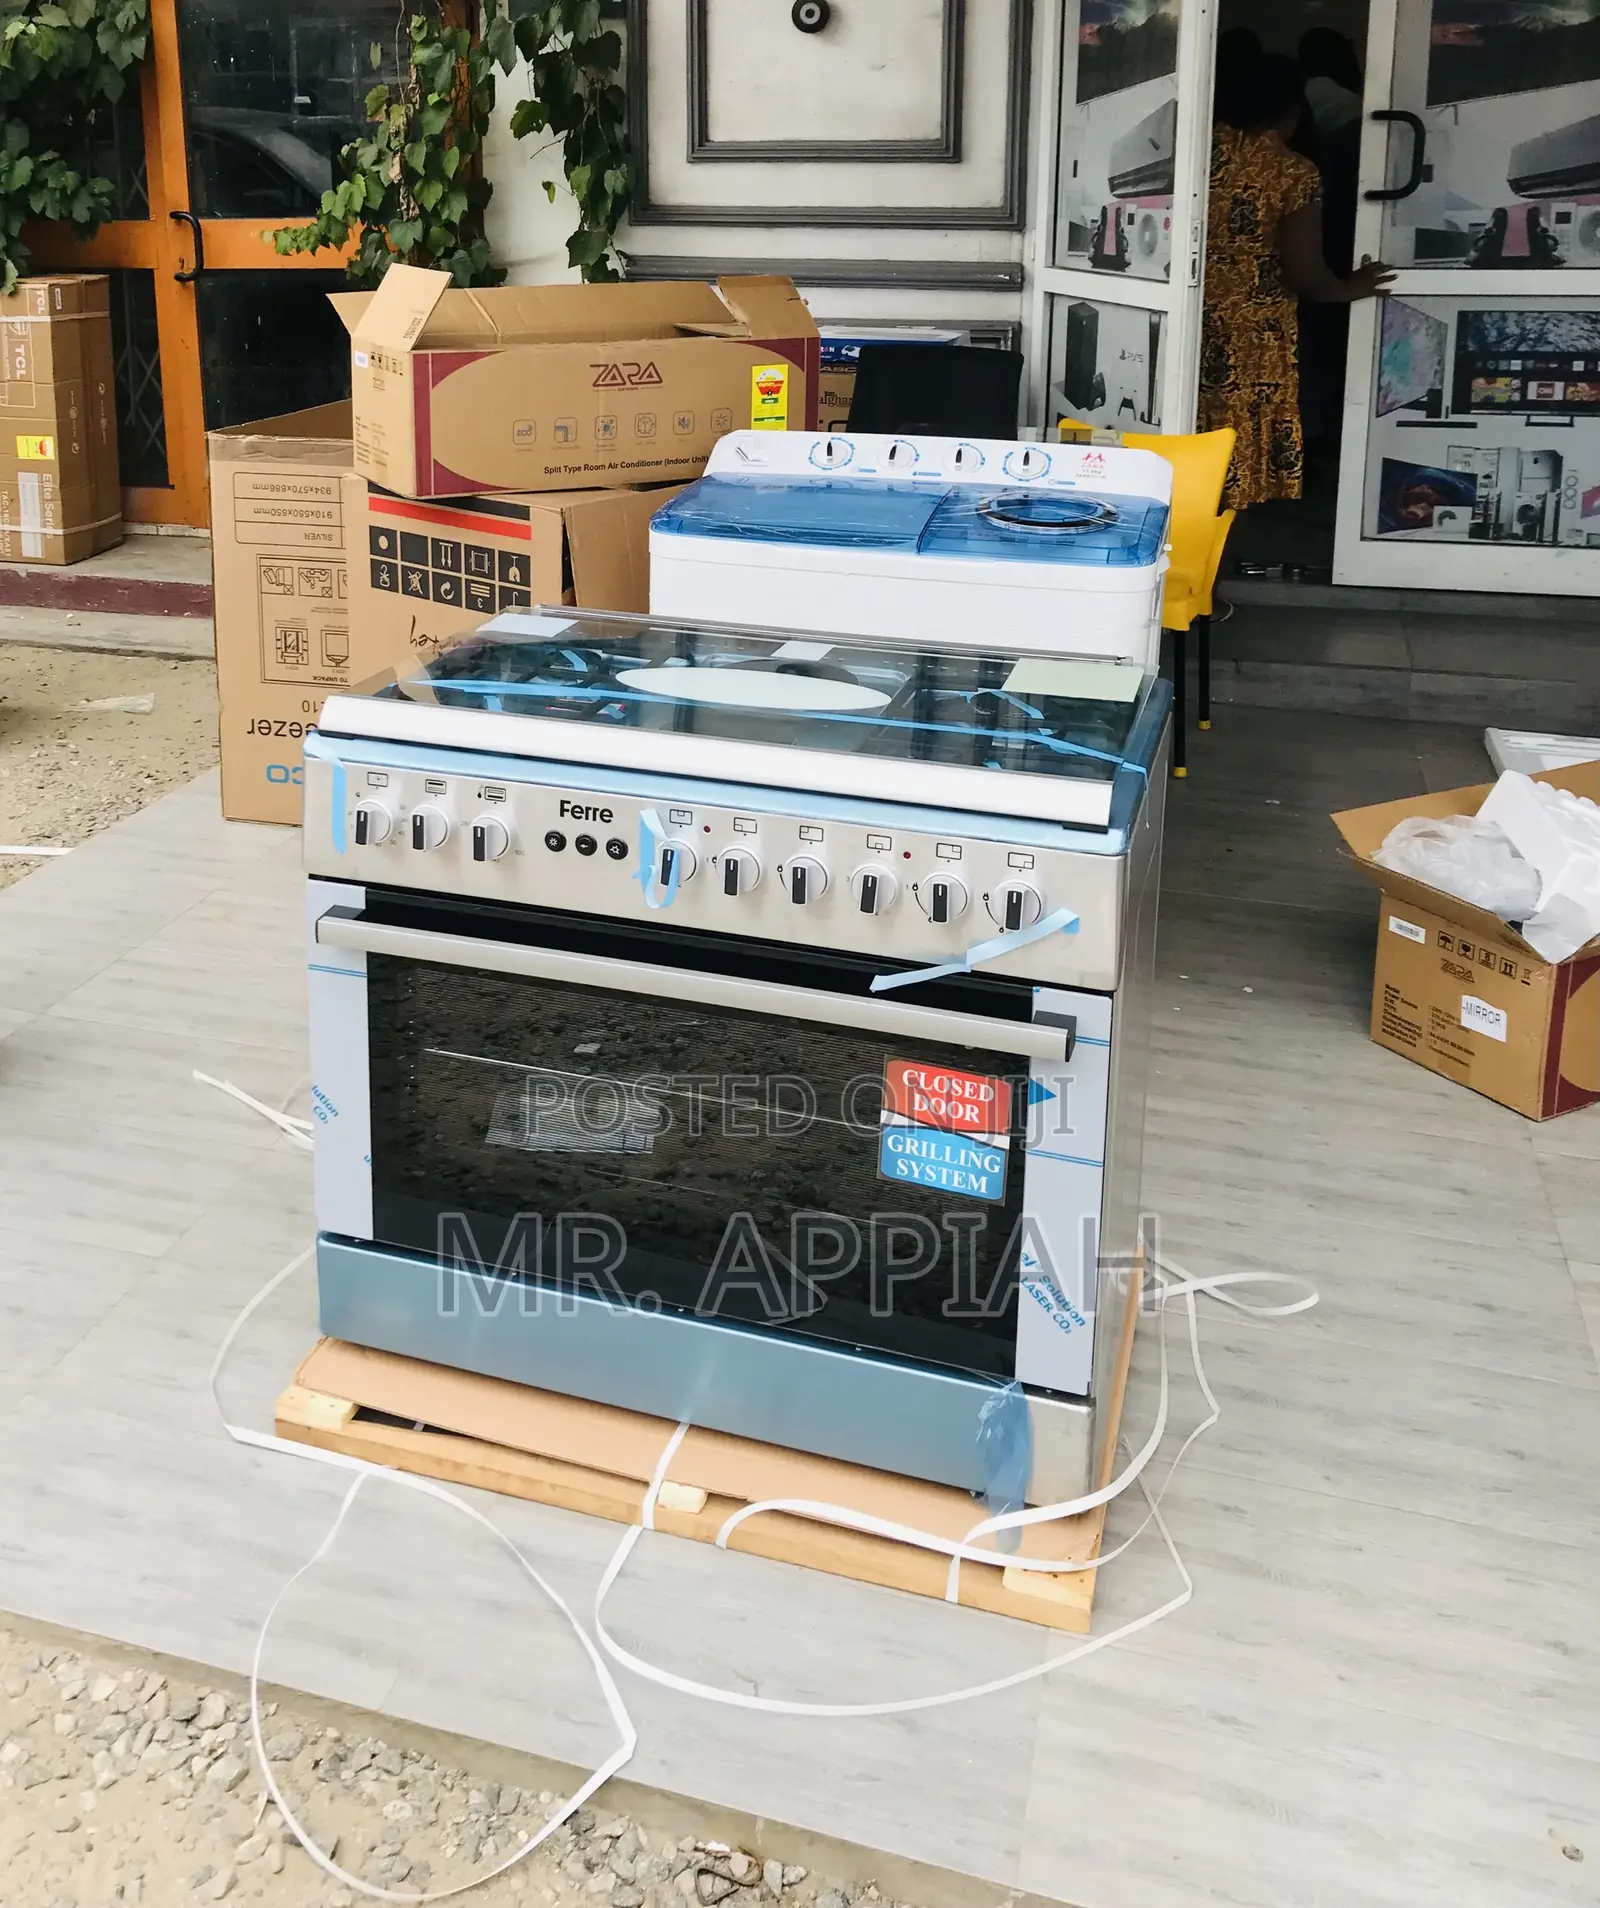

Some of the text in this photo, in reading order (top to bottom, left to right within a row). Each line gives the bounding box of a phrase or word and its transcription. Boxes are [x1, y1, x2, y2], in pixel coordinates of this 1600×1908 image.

[36, 289, 46, 314] TCL
[15, 344, 26, 379] TCL
[589, 361, 663, 387] ZARA
[544, 466, 562, 475] Split
[563, 465, 582, 474] Type
[583, 463, 606, 471] Room
[607, 462, 619, 470] Air
[620, 459, 663, 469] Conditioner
[664, 457, 690, 467] (Indoor
[42, 473, 56, 540] Elite Seris
[253, 507, 333, 519] 910x550x850mm
[303, 532, 334, 541] SILVER
[559, 799, 614, 823] Ferre
[1440, 958, 1475, 983] ZARA
[902, 1069, 995, 1102] CLOSED
[912, 1093, 981, 1124] DOOR
[887, 1134, 1001, 1173] GRILLING
[896, 1158, 988, 1194] SYSTEM
[1020, 1276, 1055, 1313] LASER
[1038, 1274, 1086, 1327] Solution
